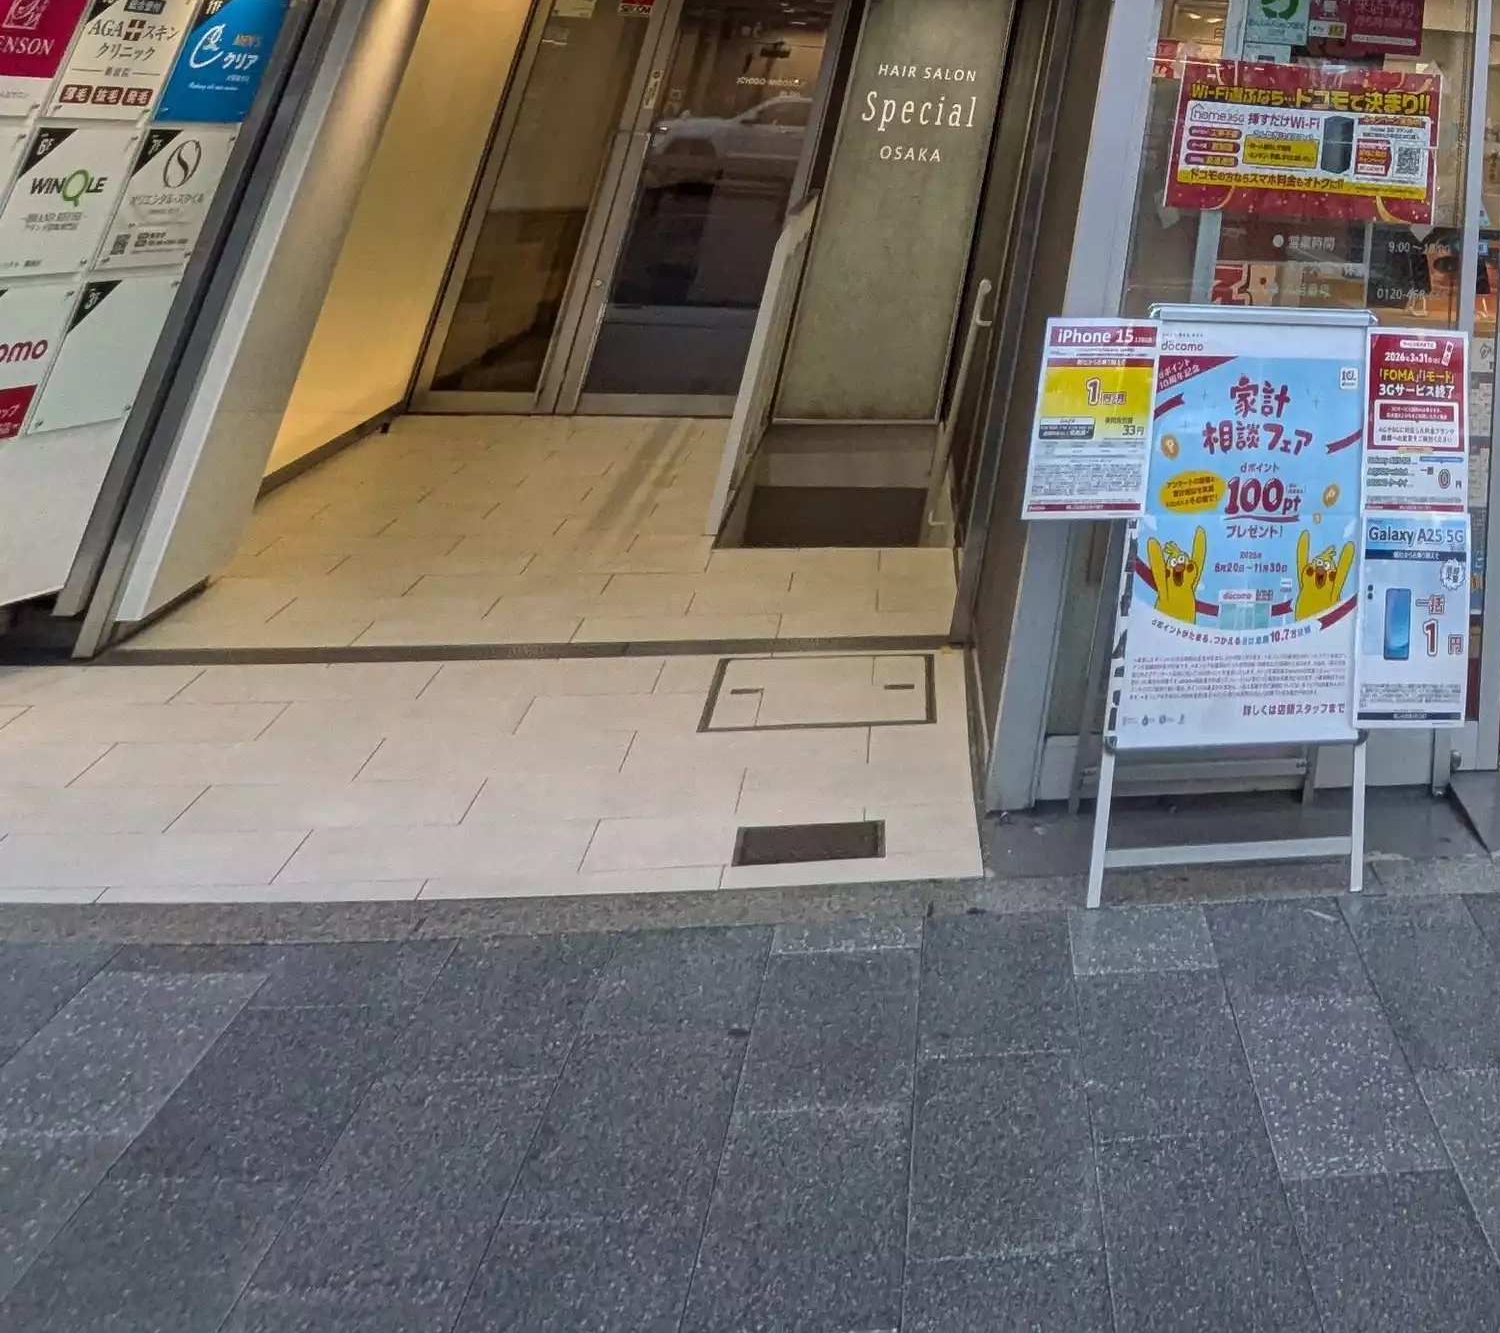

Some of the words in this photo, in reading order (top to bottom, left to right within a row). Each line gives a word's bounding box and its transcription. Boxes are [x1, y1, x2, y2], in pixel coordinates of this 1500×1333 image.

[877, 64, 917, 79] HAIR
[923, 66, 978, 83] SALON
[861, 89, 978, 133] Special
[879, 145, 943, 164] OSAKA
[1057, 328, 1112, 344] iPhone
[1115, 328, 1134, 344] 15
[1161, 340, 1204, 352] docomo
[1085, 377, 1101, 407] 1
[1230, 374, 1291, 419] 家計
[1378, 383, 1455, 400] 3Gサービス終了
[1121, 424, 1145, 436] 33円
[1202, 419, 1314, 456] 相談フェア
[1240, 461, 1280, 473] dポイント
[1367, 526, 1415, 546] Galaxy
[1417, 528, 1443, 544] A25
[1446, 529, 1465, 545] 5G
[1416, 594, 1445, 616] 一括
[1423, 619, 1439, 656] 1
[1448, 634, 1464, 655] 円
